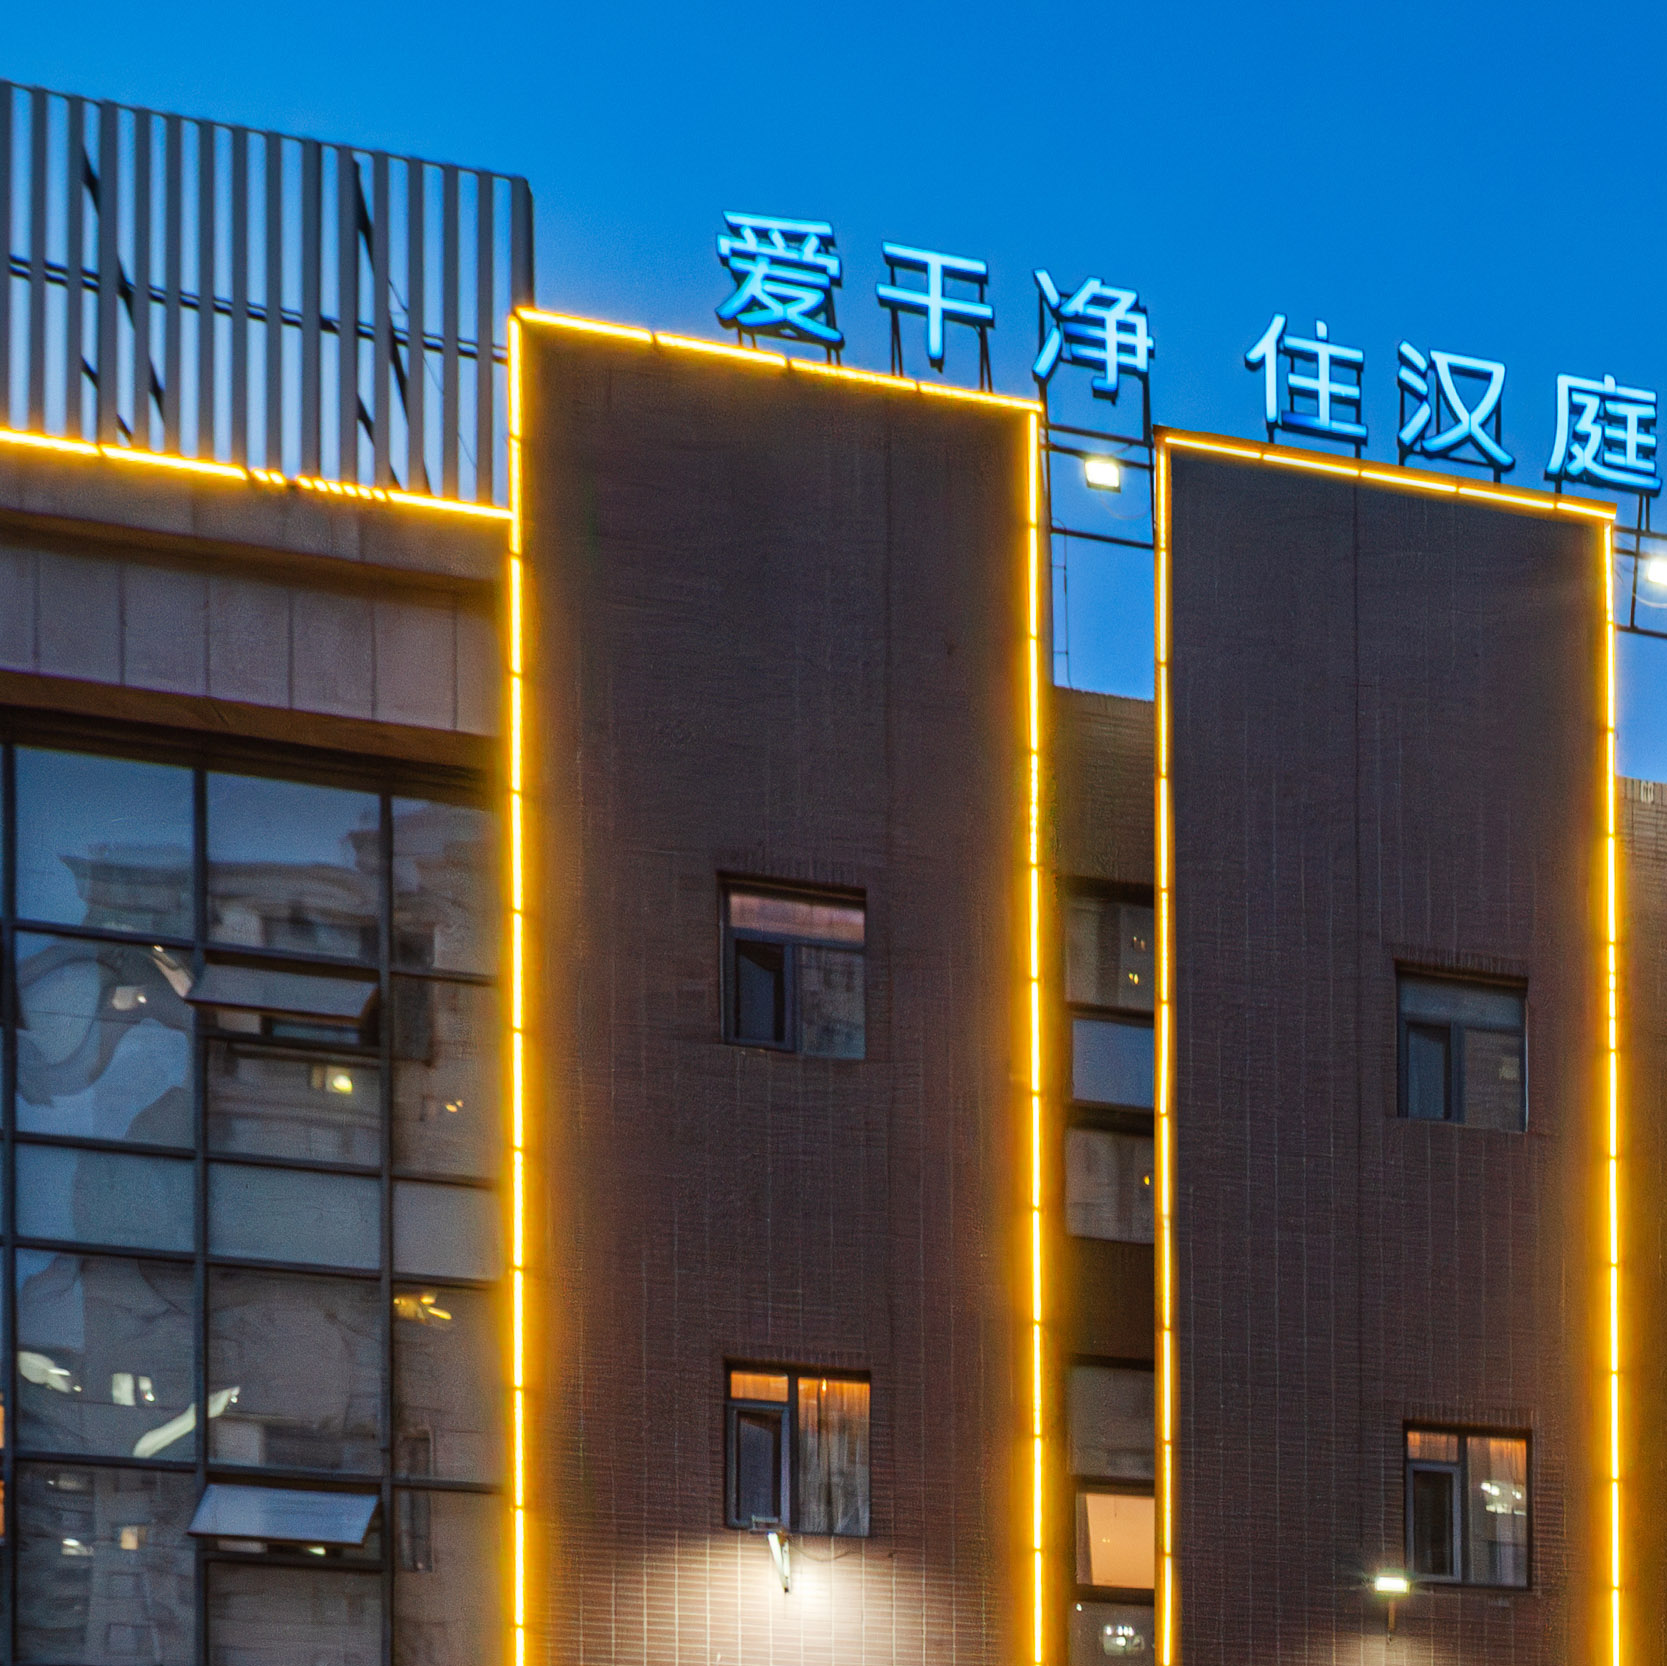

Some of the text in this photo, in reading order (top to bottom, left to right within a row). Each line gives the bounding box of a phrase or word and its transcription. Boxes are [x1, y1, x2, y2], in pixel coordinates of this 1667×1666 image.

[715, 208, 1663, 497] 爱干净 住汉庭
